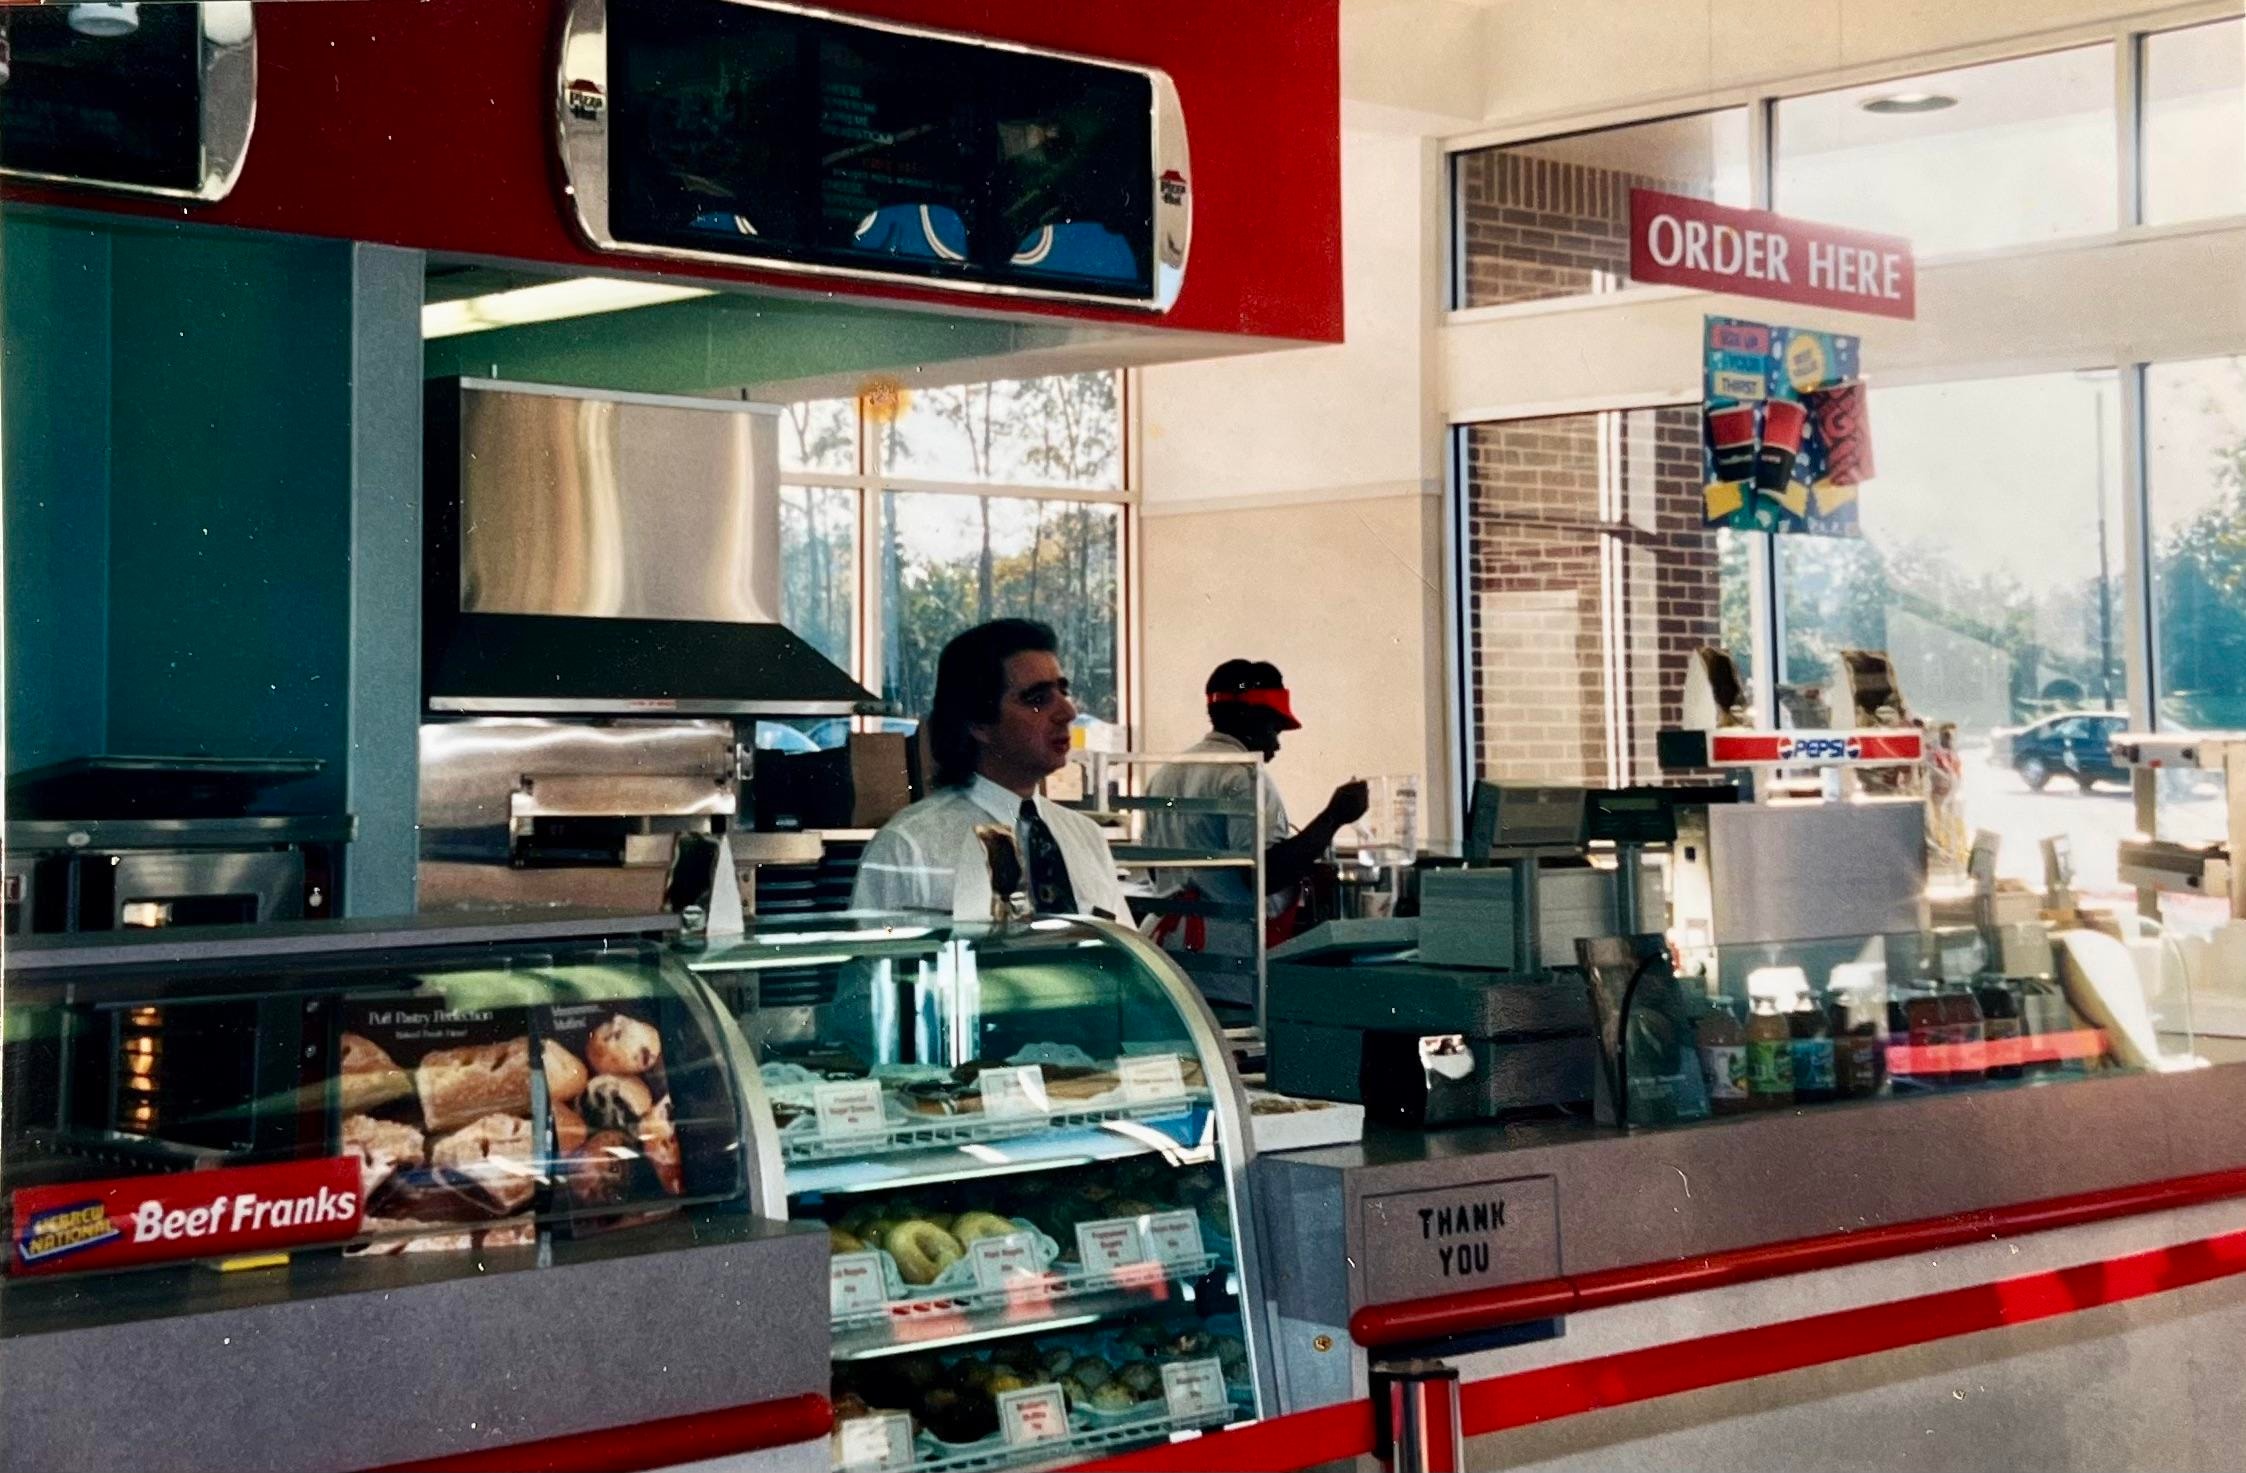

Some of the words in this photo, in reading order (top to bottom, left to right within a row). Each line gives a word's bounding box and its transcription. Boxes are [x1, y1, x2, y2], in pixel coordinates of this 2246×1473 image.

[1648, 213, 1791, 284] ORDER
[1808, 240, 1901, 300] HERE
[1794, 738, 1845, 759] PEPSI
[134, 1195, 228, 1244] Beef
[230, 1186, 357, 1233] Franks
[1418, 1201, 1506, 1240] THANK
[1438, 1242, 1490, 1277] YOU
